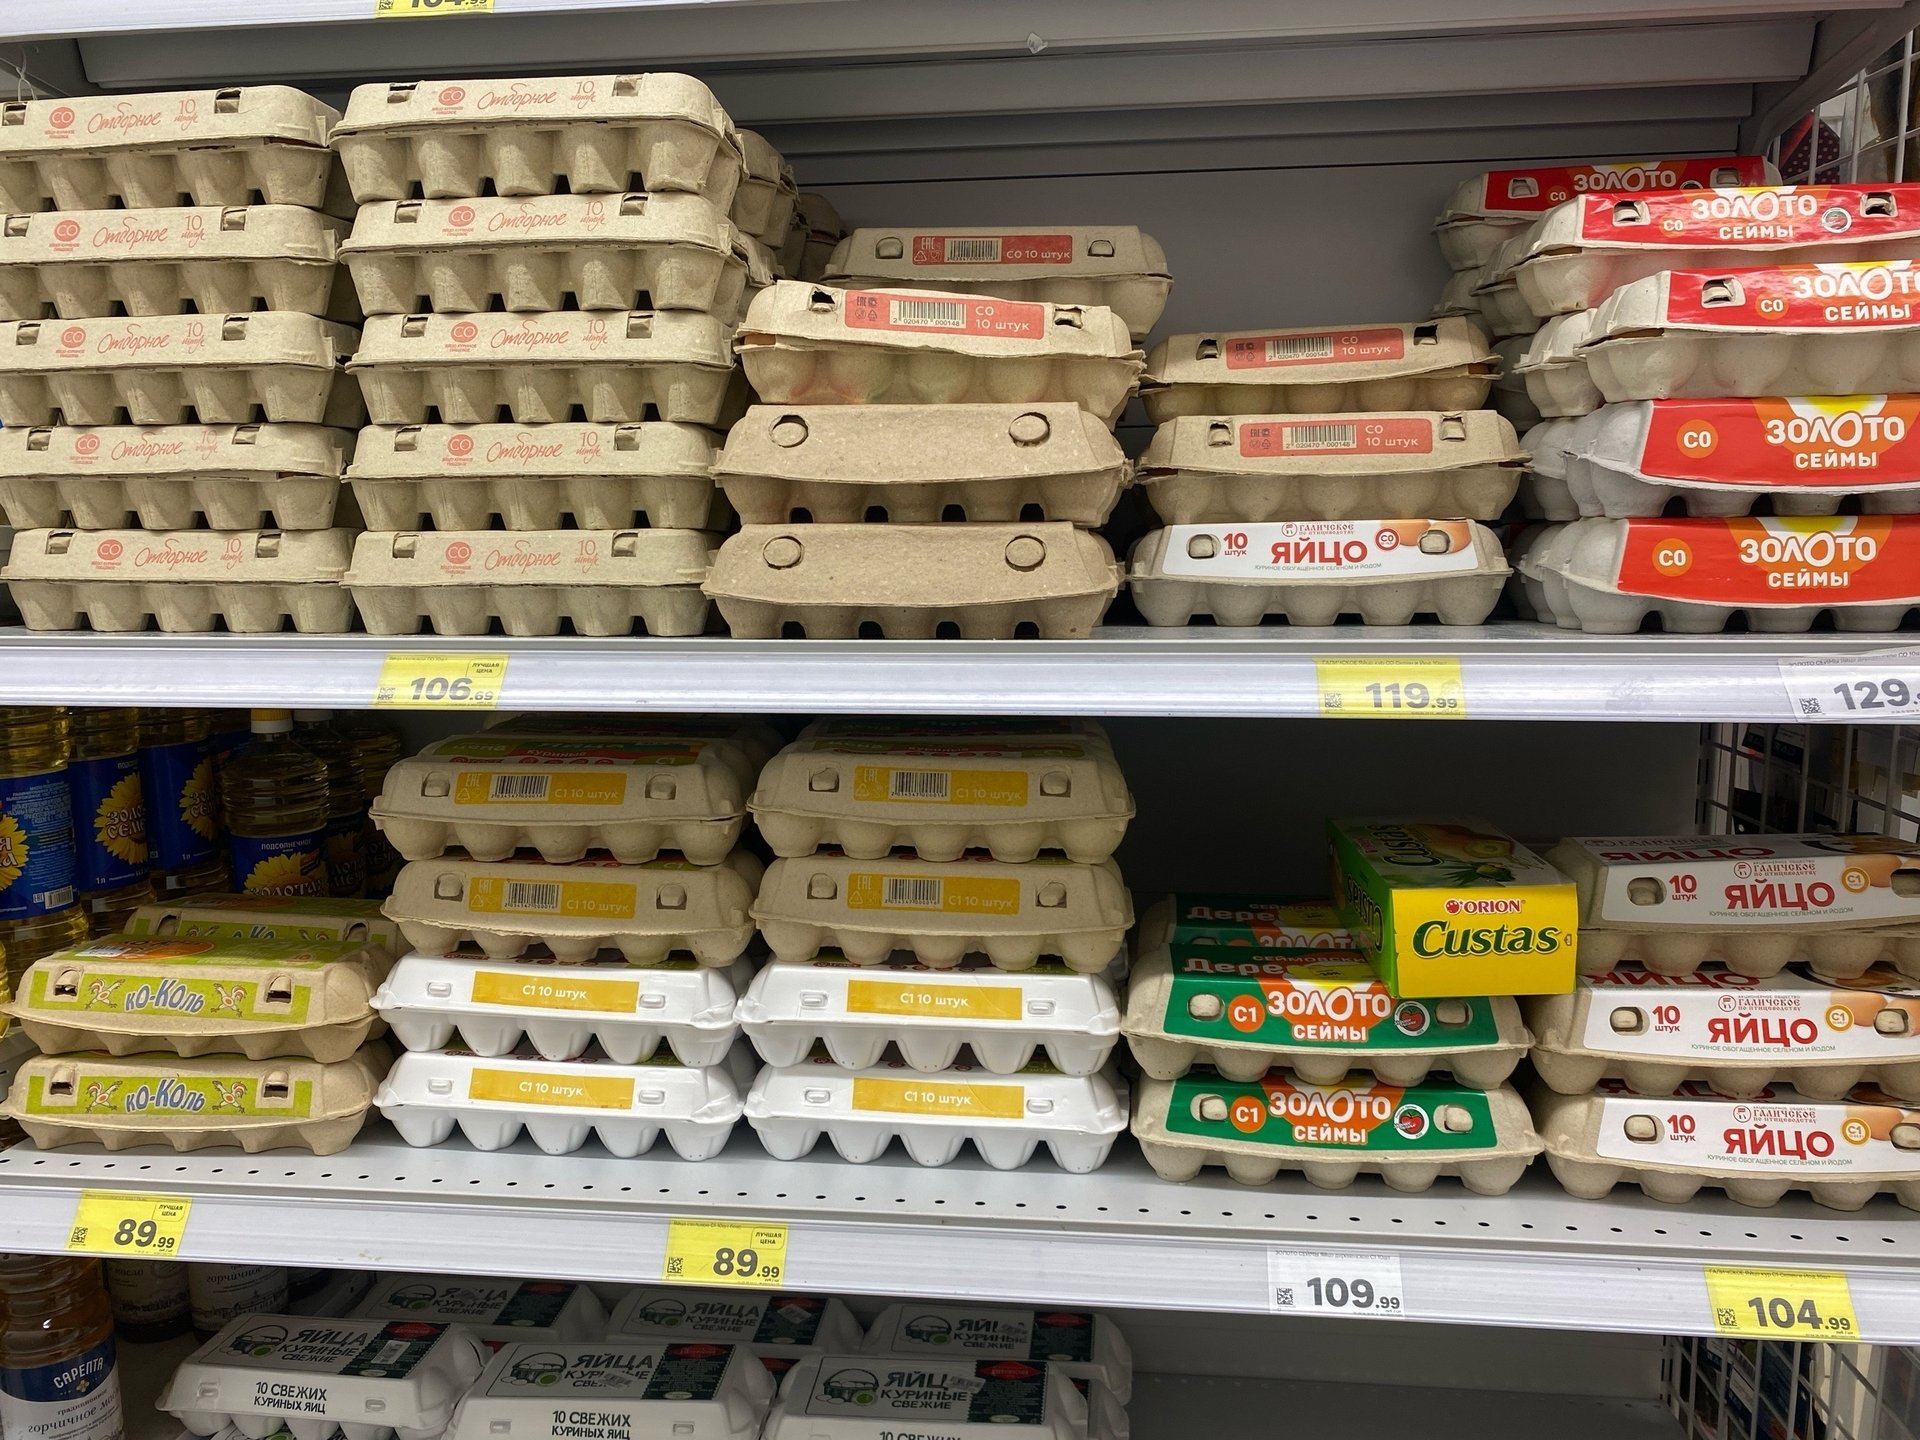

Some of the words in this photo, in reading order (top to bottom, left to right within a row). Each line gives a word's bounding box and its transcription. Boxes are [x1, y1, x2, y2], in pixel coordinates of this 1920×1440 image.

[477, 84, 557, 112] Отборное
[577, 81, 594, 95] 10
[88, 103, 161, 132] Отборное
[179, 99, 196, 114] 10
[1573, 167, 1676, 192] ЗОЛОТО
[1692, 193, 1818, 221] ЗОЛОТО
[488, 203, 567, 236] Отборное
[587, 201, 603, 216] 10
[93, 217, 168, 249] Отборное
[185, 215, 202, 231] 10
[1720, 223, 1794, 240] СЕЙМЫ
[1026, 250, 1038, 259] 10
[1041, 252, 1070, 261] штук
[1825, 302, 1910, 321] СЕЙМЫ
[491, 319, 569, 350] Отборное
[589, 319, 605, 334] 10
[975, 320, 990, 329] 10
[995, 322, 1029, 333] штук
[98, 324, 169, 356] Отборное
[187, 322, 202, 337] 10
[1342, 347, 1352, 355] 10
[1360, 346, 1391, 356] штук
[202, 430, 217, 445] 10
[1766, 411, 1906, 447] ЗОЛОТО
[487, 433, 563, 466] Отборное
[581, 432, 597, 447] 10
[1366, 437, 1380, 447] 10
[1385, 437, 1418, 449] штук
[1795, 448, 1877, 469] СЕЙМЫ
[579, 540, 595, 555] 10
[1223, 534, 1248, 551] 10
[1271, 537, 1368, 566] ЯЙЦО
[1739, 531, 1878, 567] ЗОЛОТО
[135, 539, 207, 570] Отборное
[225, 538, 241, 553] 10
[1224, 549, 1247, 558] штук
[1768, 569, 1849, 589] СЕЙМЫ
[1834, 679, 1920, 710] 129.
[571, 788, 584, 798] 10
[588, 791, 619, 800] штук
[973, 788, 986, 798] 10
[991, 791, 1022, 801] штук
[1669, 874, 1697, 894] 10
[965, 896, 978, 906] 10
[982, 898, 1013, 910] штук
[1672, 893, 1697, 903] штук
[1724, 878, 1836, 912] ЯЙЦО
[583, 900, 595, 910] 10
[600, 903, 628, 913] штук
[1464, 900, 1521, 914] ORION
[1412, 920, 1559, 958] Custas
[540, 986, 552, 998] 10
[556, 988, 588, 1002] штук
[918, 993, 931, 1005] 10
[935, 996, 968, 1009] штук
[1267, 987, 1391, 1022] ЗОЛОТО
[1652, 1005, 1681, 1024] 10
[1293, 1022, 1368, 1041] СЕЙМЫ
[1654, 1024, 1681, 1033] штук
[1707, 1012, 1819, 1047] ЯЙЦО
[535, 1082, 548, 1094] 10
[552, 1085, 583, 1098] штук
[921, 1091, 935, 1102] 10
[939, 1094, 972, 1107] штук
[1269, 1089, 1392, 1123] ЗОЛОТО
[1667, 1114, 1696, 1133] 10
[1294, 1124, 1368, 1143] СЕЙМЫ
[1669, 1133, 1696, 1143] штук
[1722, 1123, 1835, 1160] ЯЙЦО
[294, 1328, 369, 1346] ЯЙЦА
[277, 1344, 361, 1357] КУРИНЫЕ
[281, 1353, 338, 1364] СВЕЖИЕ
[571, 1354, 653, 1371] ЯЙЦА
[53, 1357, 104, 1389] САРЕПТА
[255, 1381, 268, 1395] 10
[270, 1383, 327, 1401] СВЕЖИХ
[880, 1388, 968, 1402] КУРИНЫЕ
[253, 1396, 303, 1411] КУРИНЫХ
[304, 1402, 327, 1414] ЯИЦ
[891, 1399, 952, 1410] СВЕЖИЕ
[552, 1410, 566, 1424] 10
[569, 1411, 632, 1427] СВЕЖИХ
[551, 1424, 606, 1438] КУРИНЫХ
[606, 1427, 631, 1440] ЯИЦ
